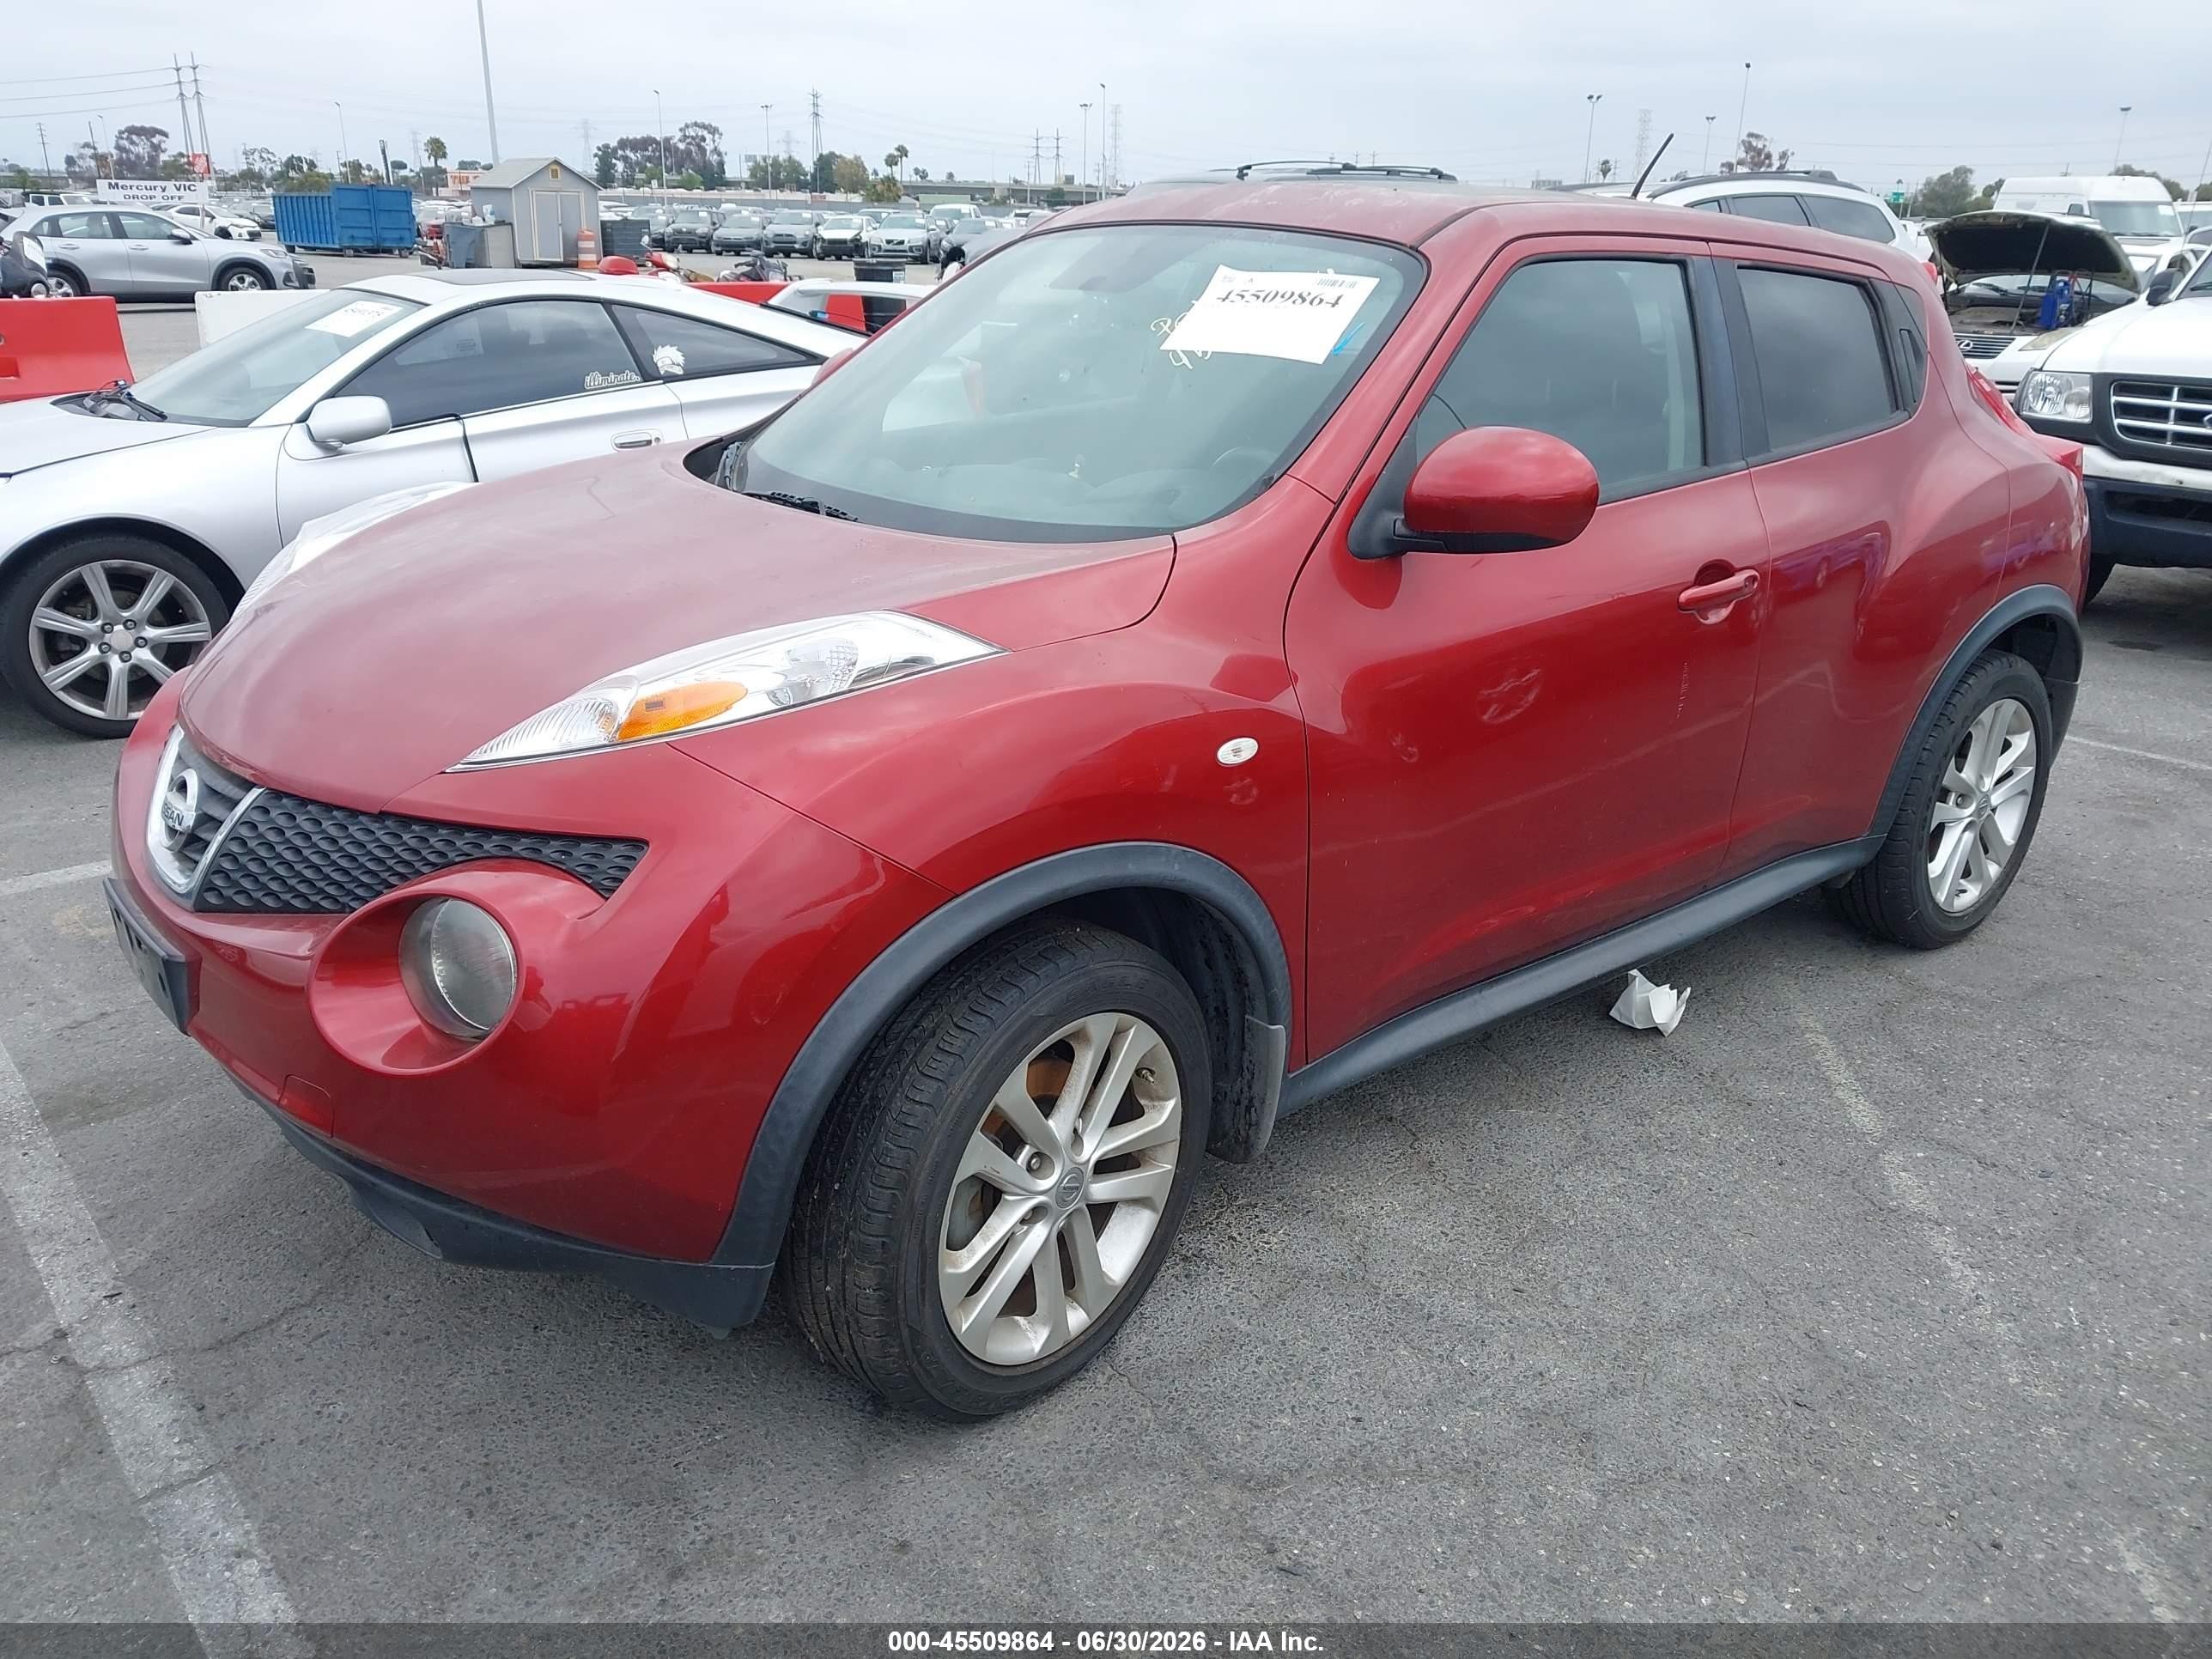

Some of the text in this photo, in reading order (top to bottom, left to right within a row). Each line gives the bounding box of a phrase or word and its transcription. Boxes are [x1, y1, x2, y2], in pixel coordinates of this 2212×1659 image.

[107, 181, 197, 192] Mercury VIC
[1216, 289, 1345, 308] 45509864
